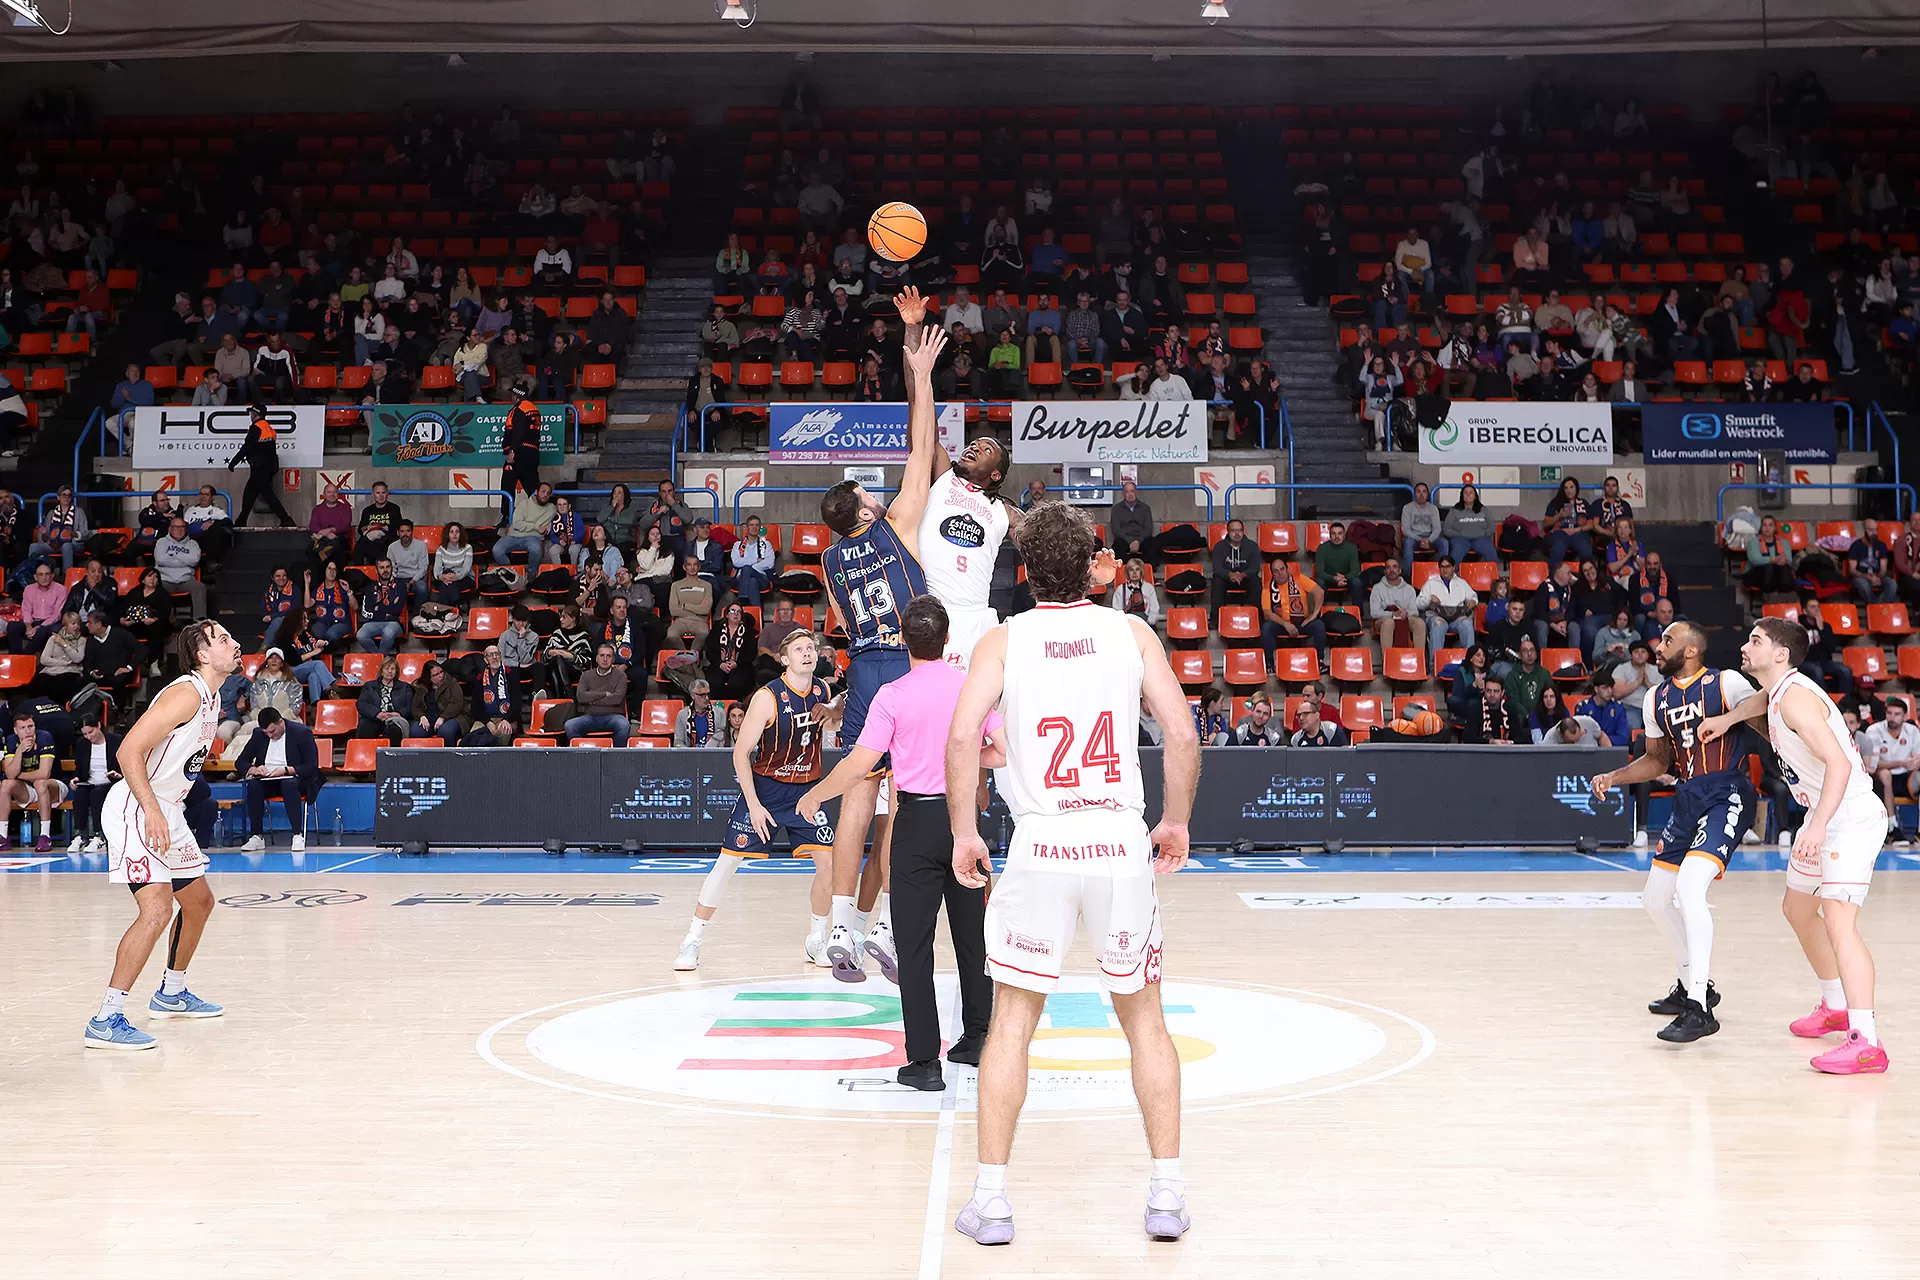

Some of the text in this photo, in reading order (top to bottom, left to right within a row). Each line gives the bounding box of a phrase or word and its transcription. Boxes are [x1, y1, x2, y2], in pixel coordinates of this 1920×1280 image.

[1020, 402, 1190, 453] Burpellet
[1468, 417, 1498, 425] GRUPO
[1725, 414, 1776, 426] Smurfit
[1469, 423, 1607, 444] IBEREÓLICA
[1725, 426, 1785, 439] Westrock
[782, 451, 829, 460] 947 298 732
[1151, 444, 1200, 459] Natural
[1549, 445, 1608, 453] RENOVABLES
[1678, 449, 1717, 459] mundial
[1718, 451, 1731, 459] en
[705, 473, 718, 492] 6
[1257, 470, 1271, 490] 6
[947, 527, 979, 543] Galicia
[948, 519, 981, 535] Estrella
[842, 541, 875, 561] VILA
[847, 554, 897, 580] IBEREÓLICA
[956, 555, 967, 573] 9
[849, 578, 895, 624] 13
[1045, 637, 1096, 660] MCDONNELL
[1667, 701, 1703, 726] TZN
[800, 731, 812, 746] 8
[1680, 728, 1694, 749] 5
[1037, 711, 1122, 789] 24
[625, 789, 691, 806] Julian
[1257, 788, 1324, 806] Julian
[610, 803, 691, 820] Automotive
[1242, 802, 1324, 818] Automotive
[1033, 844, 1126, 860] TRANSITERIA
[391, 897, 661, 907] FEB
